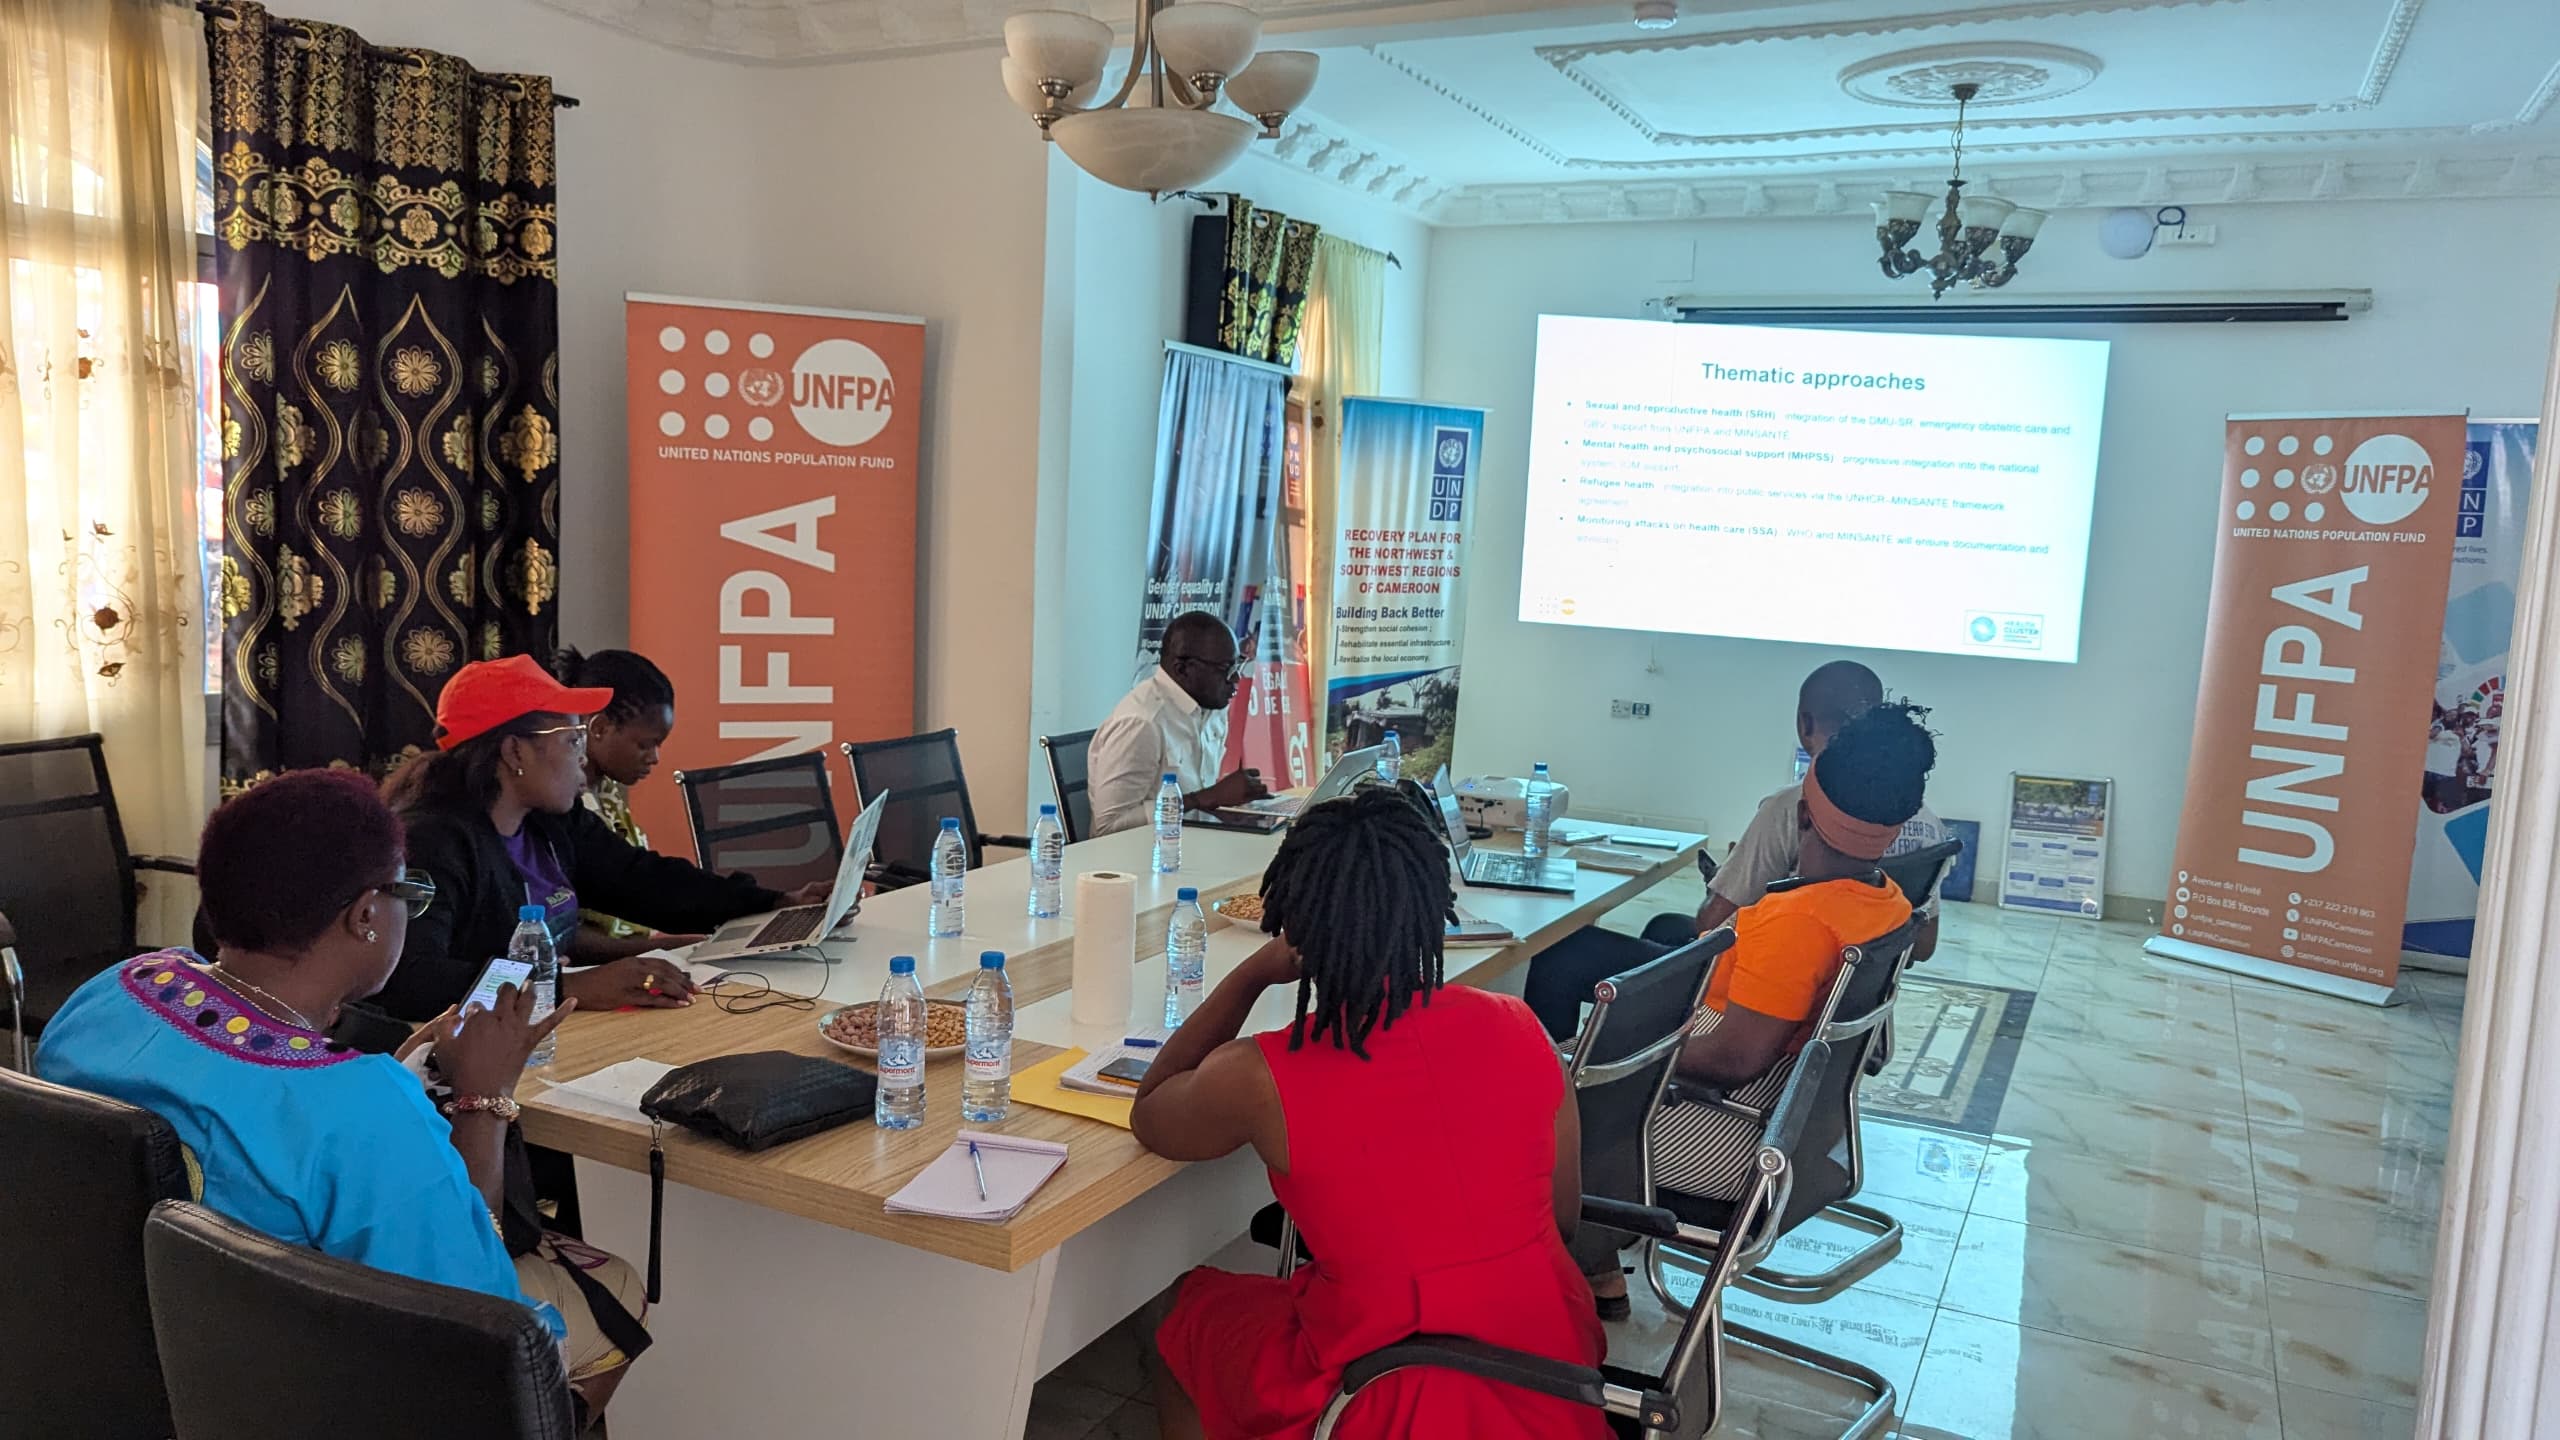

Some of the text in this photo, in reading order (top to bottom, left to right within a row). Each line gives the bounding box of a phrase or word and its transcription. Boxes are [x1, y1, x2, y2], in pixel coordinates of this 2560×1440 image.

[1700, 362, 1925, 391] Thematic approaches
[791, 372, 894, 412] UNFPA
[1585, 399, 1618, 410] Sexual
[1622, 403, 1641, 412] and
[1644, 404, 1708, 414] reproductive
[1711, 407, 1741, 417] health
[1746, 409, 1776, 420] (SRH)
[2050, 424, 2071, 436] and
[659, 446, 894, 469] UNITED NATIONS POPULATION FUND
[1582, 439, 1615, 448] Mental
[1618, 442, 1648, 450] health
[1652, 444, 1671, 453] and
[1674, 446, 1742, 457] psychosocial
[1745, 450, 1784, 460] support
[1788, 450, 1834, 464] (MHPSS)
[1999, 463, 2040, 475] national
[1579, 477, 1620, 488] Refugee
[1624, 481, 1654, 489] health
[2341, 464, 2431, 494] UNFPA
[1345, 529, 1461, 545] RECOVERY PLAN FOR
[1576, 514, 1630, 528] Monitoring
[1634, 519, 1670, 529] attacks
[1688, 522, 1720, 532] health
[1748, 526, 1778, 537] (SSA)
[1952, 539, 2026, 553] documentation
[2029, 544, 2049, 555] and
[2233, 527, 2426, 543] UNITED NATIONS POPULATION FUND
[1348, 546, 1453, 561] THE NORTHWEST &
[1340, 564, 1461, 578] SOUTHWEST REGIONS
[1181, 578, 1213, 598] equality
[1359, 582, 1440, 594] OF CAMEROON
[1144, 602, 1171, 620] UNDP
[1336, 606, 1445, 621] Building Back Better
[718, 495, 836, 868] UNFPA
[2237, 565, 2369, 873] UNFPA
